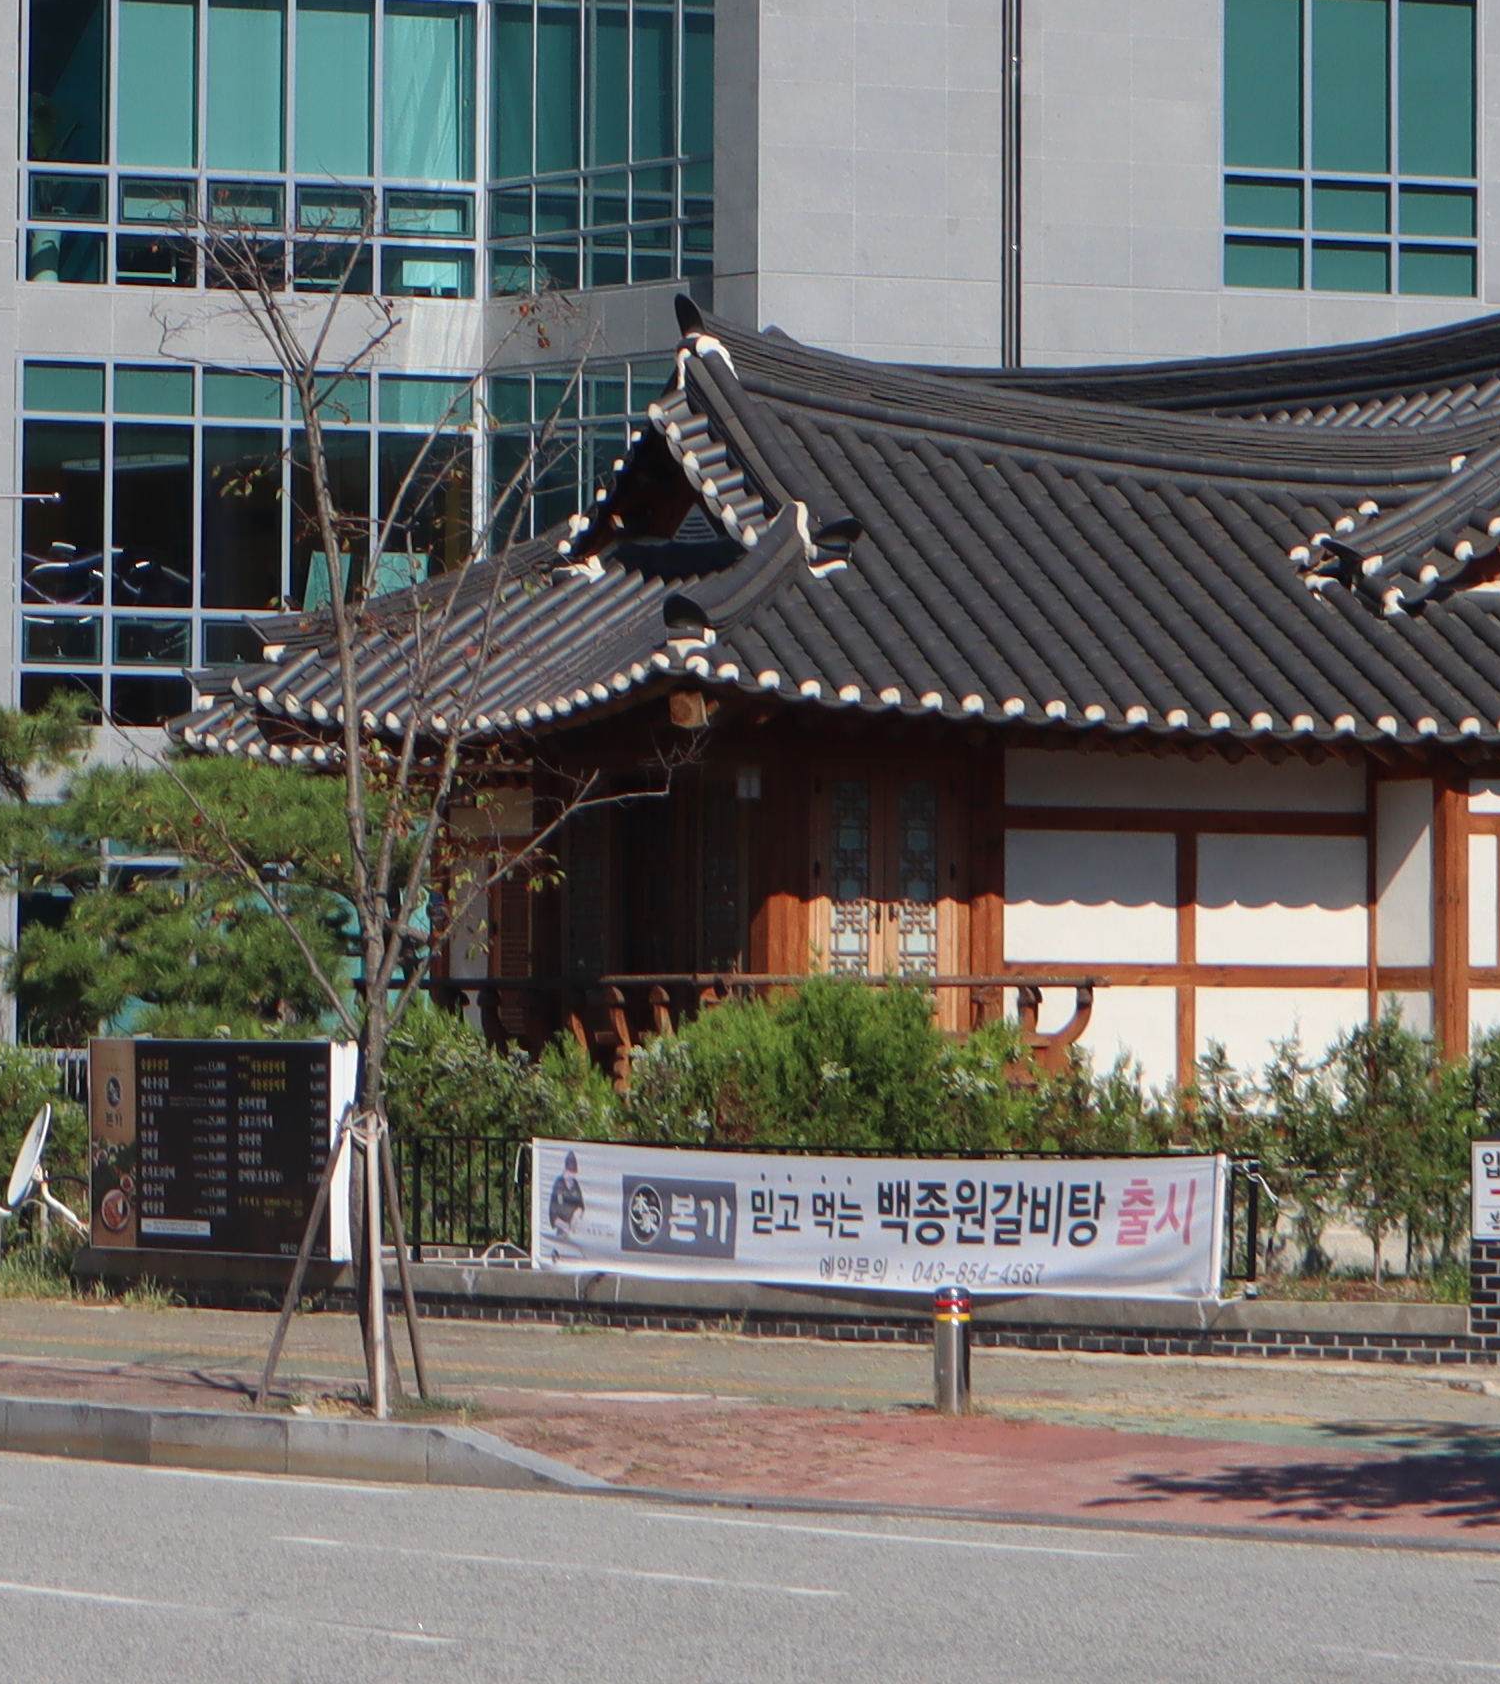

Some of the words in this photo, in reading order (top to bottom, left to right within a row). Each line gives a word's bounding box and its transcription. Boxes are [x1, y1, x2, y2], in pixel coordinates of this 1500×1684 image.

[668, 1192, 732, 1245] 본가
[750, 1186, 801, 1236] 믿고
[812, 1186, 864, 1240] 먹는
[877, 1179, 1106, 1248] 백종원갈비탕
[1115, 1178, 1198, 1247] 출시
[819, 1255, 888, 1284] 예약문의
[912, 1263, 1045, 1286] 043-854-4567
